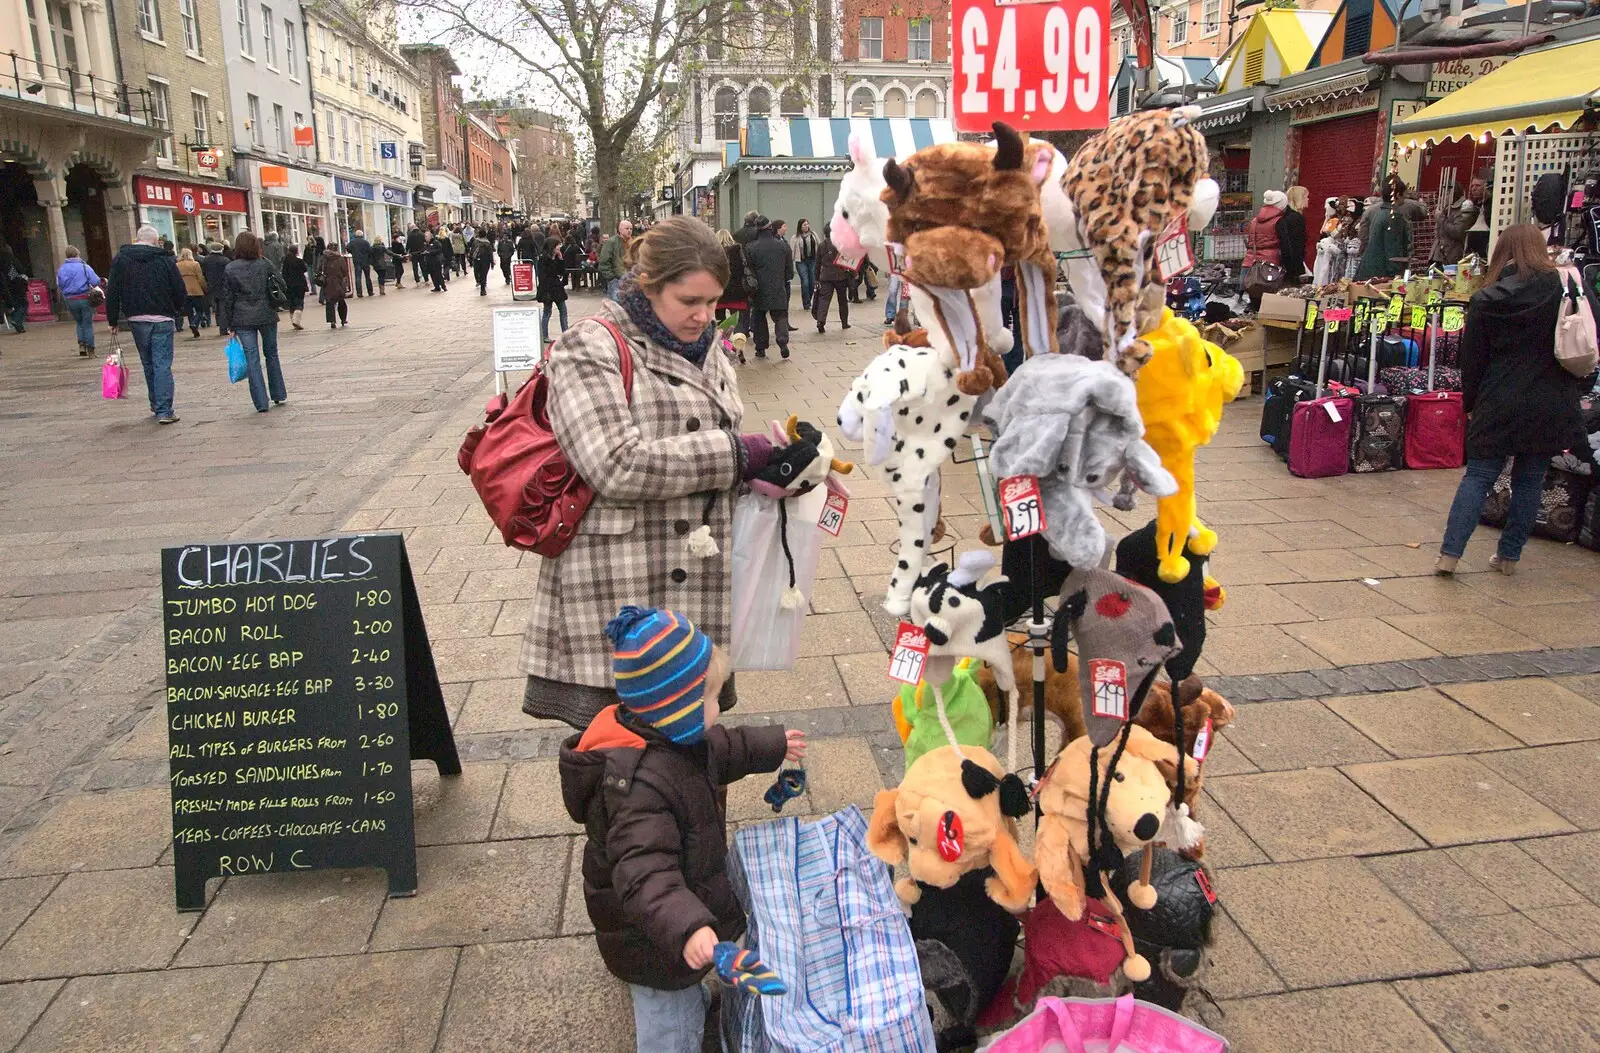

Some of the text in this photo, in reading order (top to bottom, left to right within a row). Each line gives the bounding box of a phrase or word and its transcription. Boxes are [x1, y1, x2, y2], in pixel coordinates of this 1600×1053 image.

[961, 6, 1101, 113] £4.99
[1336, 98, 1353, 112] and
[177, 538, 373, 586] CHARLIES
[168, 597, 236, 616] JUMBO
[245, 596, 275, 612] HOT
[283, 593, 317, 610] DOG
[169, 627, 226, 645] BACON
[241, 625, 284, 641] ROLL
[898, 629, 928, 648] Sale
[269, 651, 304, 669] BAP
[305, 679, 333, 695] BAP
[172, 710, 236, 731] CHICKEN
[243, 709, 297, 727] BURGER
[170, 744, 195, 759] ALL
[199, 741, 236, 758] TYPES
[257, 738, 313, 754] BURGERS
[318, 736, 347, 749] FROM
[171, 770, 227, 787] TOASTED
[236, 764, 320, 784] SANDWICHES
[175, 799, 224, 815] FRESHLY
[226, 799, 256, 812] MADE
[259, 797, 288, 810] FILLE
[291, 796, 319, 808] ROLLS
[325, 794, 353, 806] FROM
[220, 849, 312, 875] ROW C
